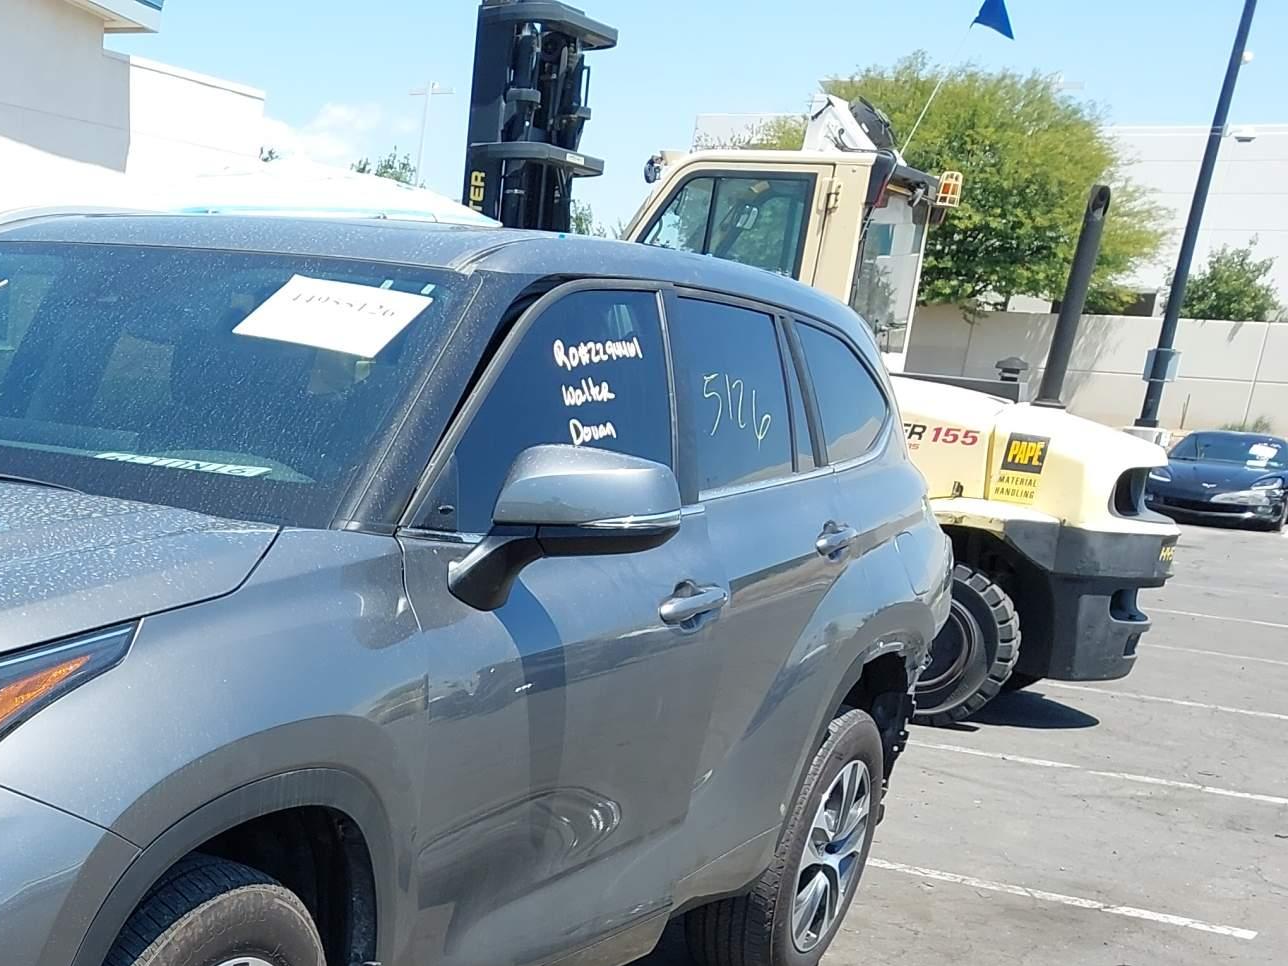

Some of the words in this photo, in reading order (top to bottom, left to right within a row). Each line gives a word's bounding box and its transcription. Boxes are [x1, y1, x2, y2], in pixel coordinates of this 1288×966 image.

[703, 373, 772, 451] 5126
[931, 426, 980, 446] 155
[998, 475, 1038, 488] MATERIAL
[994, 486, 1035, 500] HANDLING
